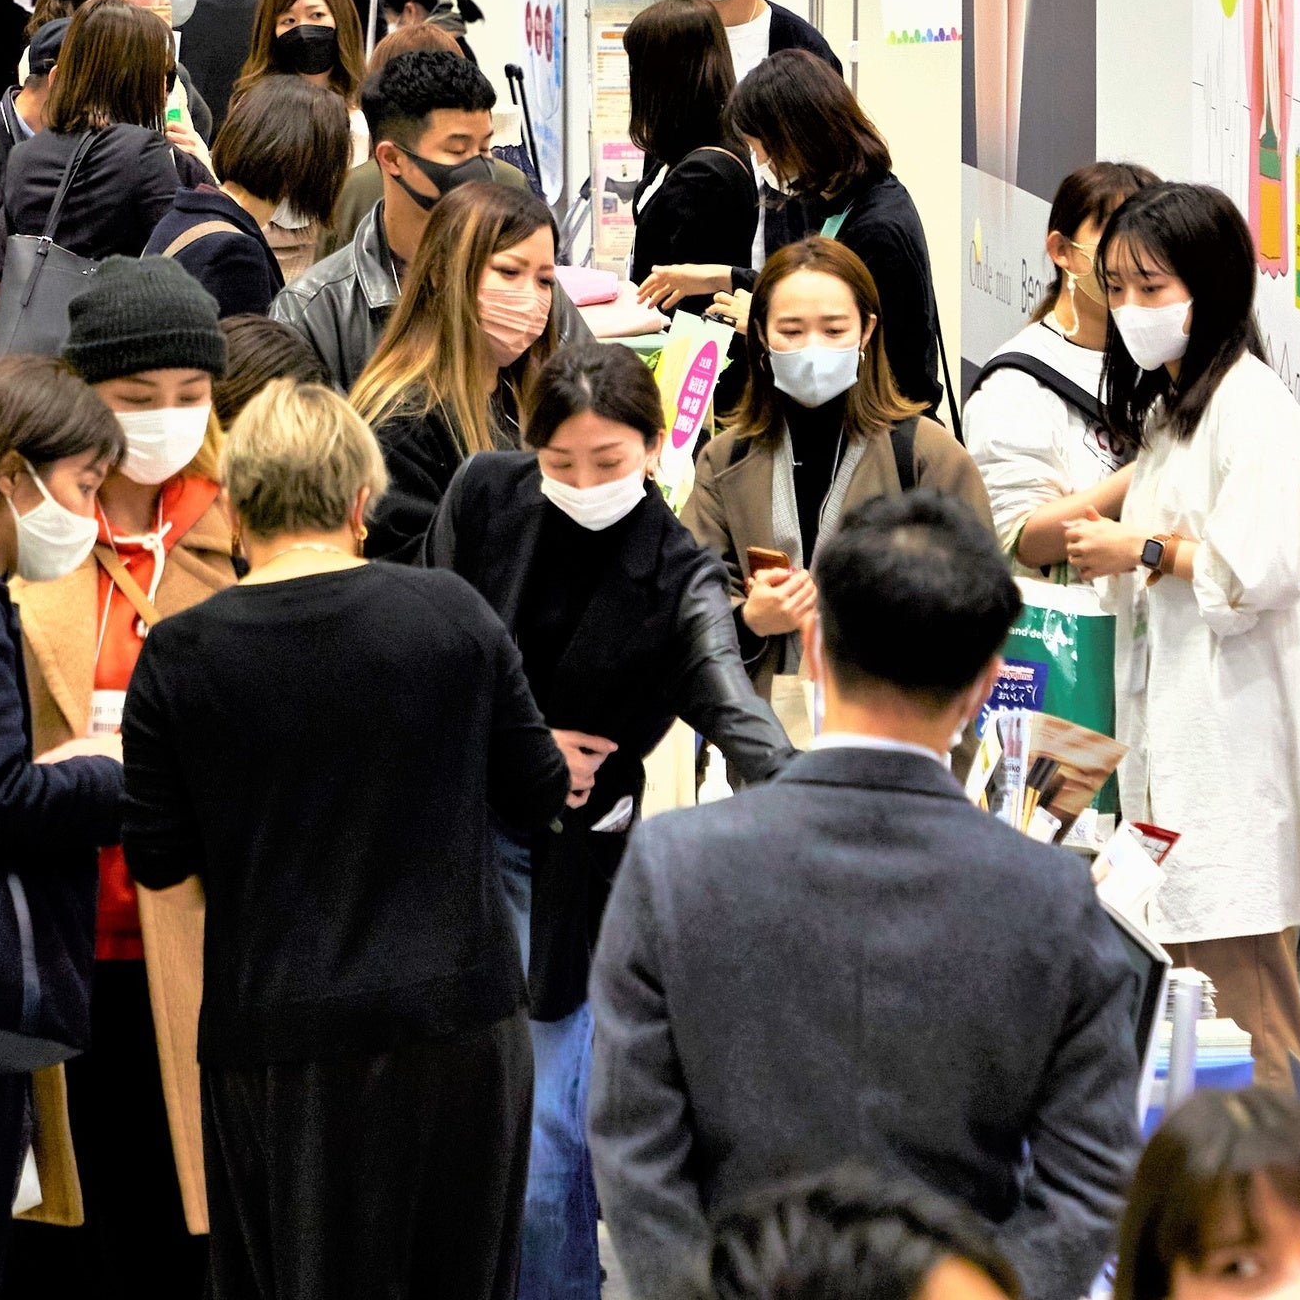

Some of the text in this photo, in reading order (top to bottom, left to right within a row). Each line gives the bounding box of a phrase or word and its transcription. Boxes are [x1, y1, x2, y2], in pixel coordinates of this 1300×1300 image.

[994, 683, 1034, 693] ヘルシーで
[998, 692, 1025, 703] おいしく
